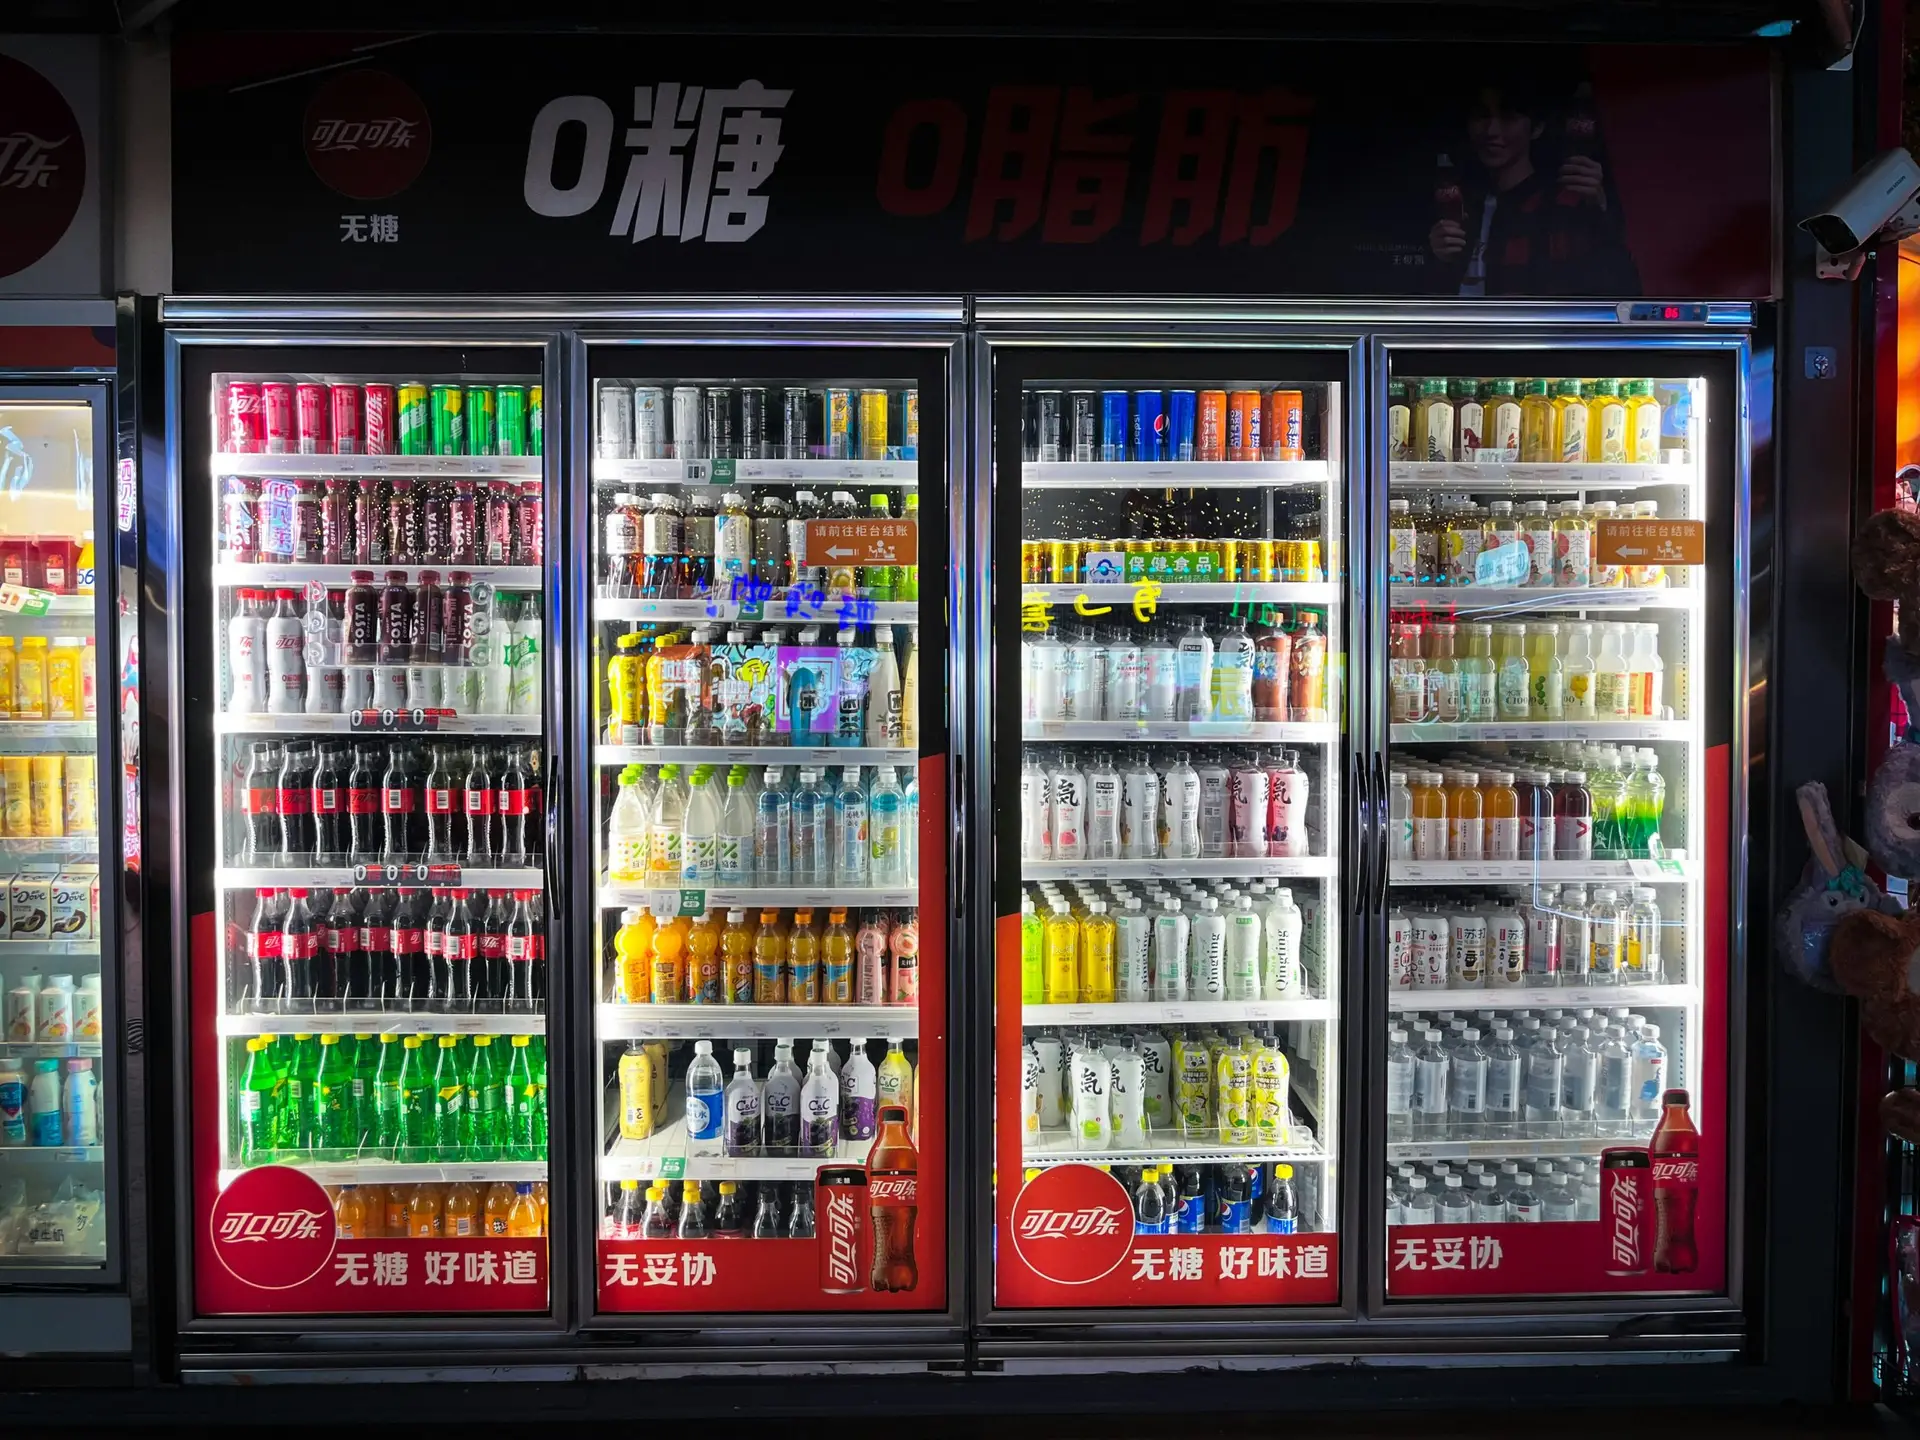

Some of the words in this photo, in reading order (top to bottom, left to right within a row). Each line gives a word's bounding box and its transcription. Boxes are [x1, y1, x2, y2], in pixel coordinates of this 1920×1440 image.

[312, 117, 420, 151] 可口可乐
[524, 78, 794, 243] 0糖
[875, 83, 1316, 246] 0脂肪
[339, 214, 399, 243] 无糖
[1203, 407, 1217, 449] 北冰洋
[1286, 408, 1300, 449] 北冰洋
[428, 512, 438, 556] COSTA
[815, 525, 908, 537] 请前往柜台结账
[1606, 525, 1696, 537] 请前往柜台结账
[1129, 556, 1211, 573] 保健食品
[354, 602, 366, 648] COSTA
[391, 603, 402, 648] COSTA
[1056, 778, 1080, 807] 氣
[1273, 777, 1292, 805] 氣
[12, 891, 47, 903] Dove
[52, 891, 86, 904] Dove
[1464, 929, 1486, 940] 苏打
[1207, 933, 1221, 993] Qingting
[1276, 929, 1289, 991] Qingting
[1143, 1047, 1164, 1074] 氣
[879, 1076, 899, 1088] C&C
[1081, 1068, 1103, 1095] 氣
[736, 1098, 758, 1112] C&C
[768, 1096, 790, 1108] C&C
[808, 1099, 830, 1112] C&C
[1652, 1161, 1699, 1180] 可口可乐
[870, 1179, 917, 1198] 可口可乐
[220, 1208, 328, 1243] 可口可乐
[826, 1187, 856, 1284] 可口可乐
[1021, 1206, 1126, 1239] 可口可乐
[1610, 1172, 1640, 1266] 可口可乐
[334, 1253, 408, 1286] 无糖
[424, 1251, 537, 1285] 好味道
[605, 1252, 717, 1287] 无妥协
[1132, 1248, 1203, 1281] 无糖
[1219, 1245, 1328, 1279] 好味道
[1394, 1236, 1503, 1271] 无妥协
